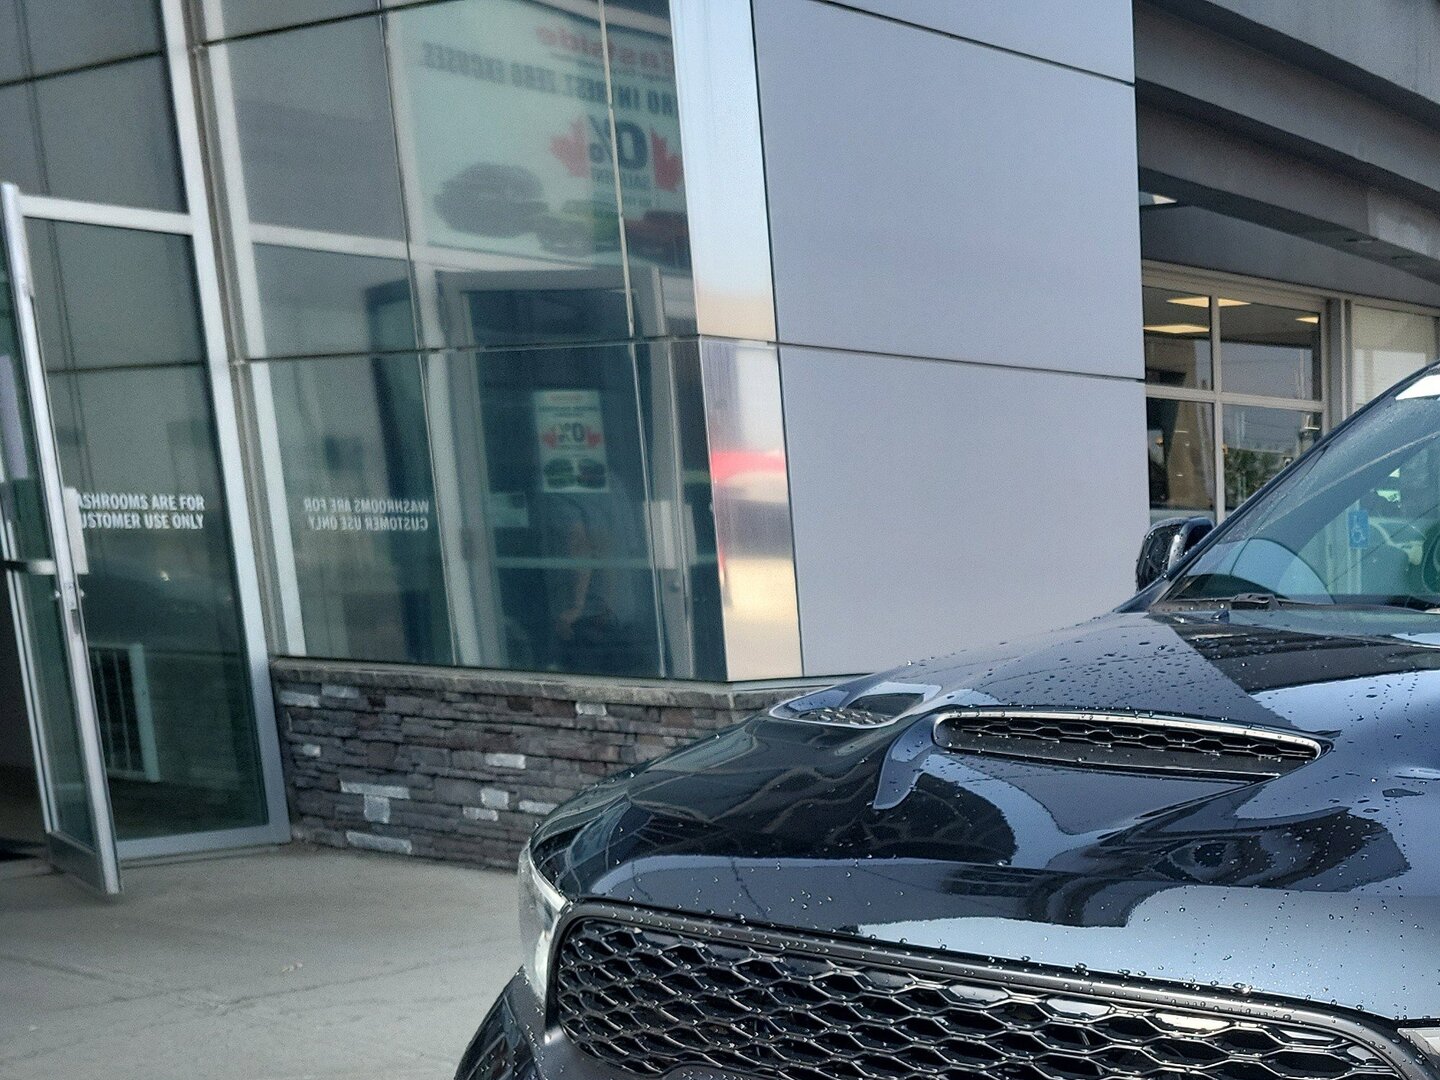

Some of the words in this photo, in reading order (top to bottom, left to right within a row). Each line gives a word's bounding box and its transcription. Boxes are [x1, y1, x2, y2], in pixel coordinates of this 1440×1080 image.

[79, 492, 148, 510] ASHROOMS
[152, 493, 177, 511] ARE
[180, 494, 205, 511] FOR
[81, 511, 140, 529] USTOMER
[144, 512, 171, 529] USE
[172, 513, 204, 529] ONLY
